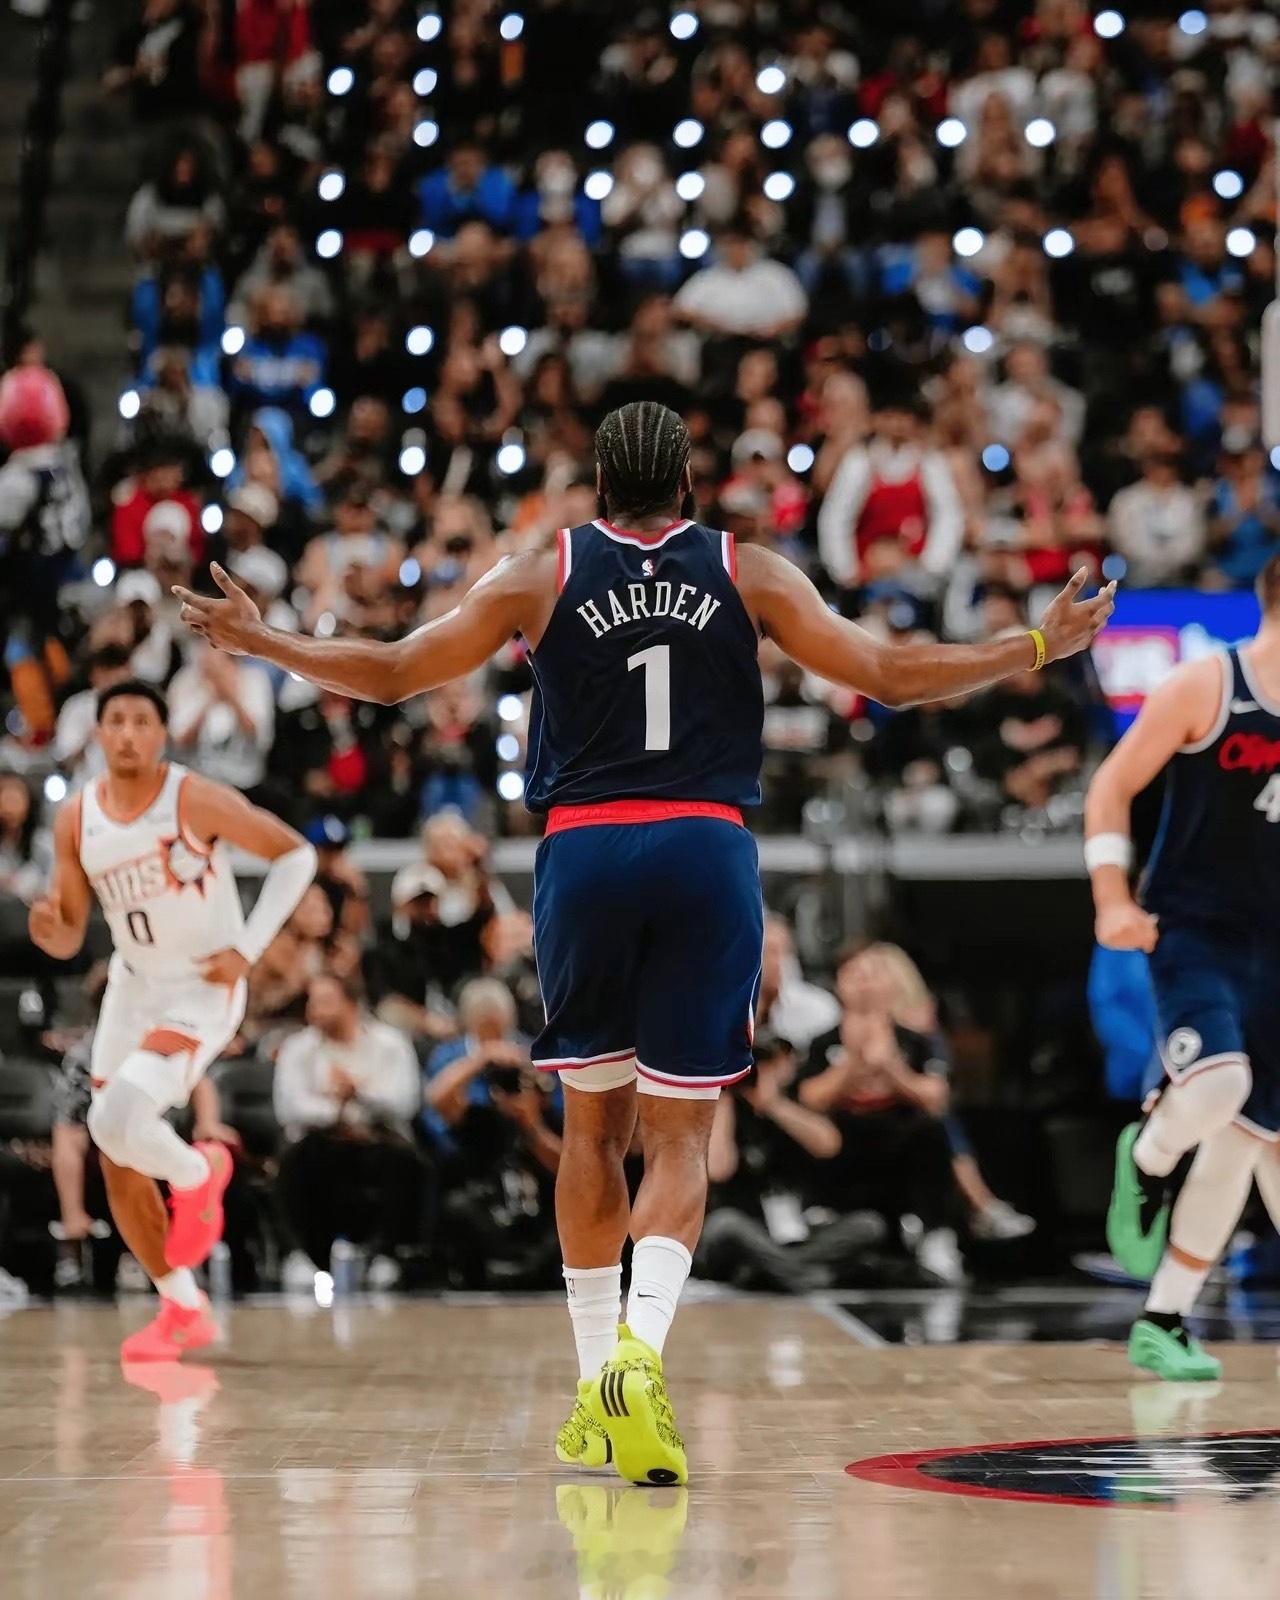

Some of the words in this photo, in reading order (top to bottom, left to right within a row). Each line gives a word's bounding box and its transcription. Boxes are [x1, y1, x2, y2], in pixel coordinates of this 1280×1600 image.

[576, 581, 721, 638] HARDEN
[627, 644, 671, 751] 1
[127, 910, 155, 945] 0
